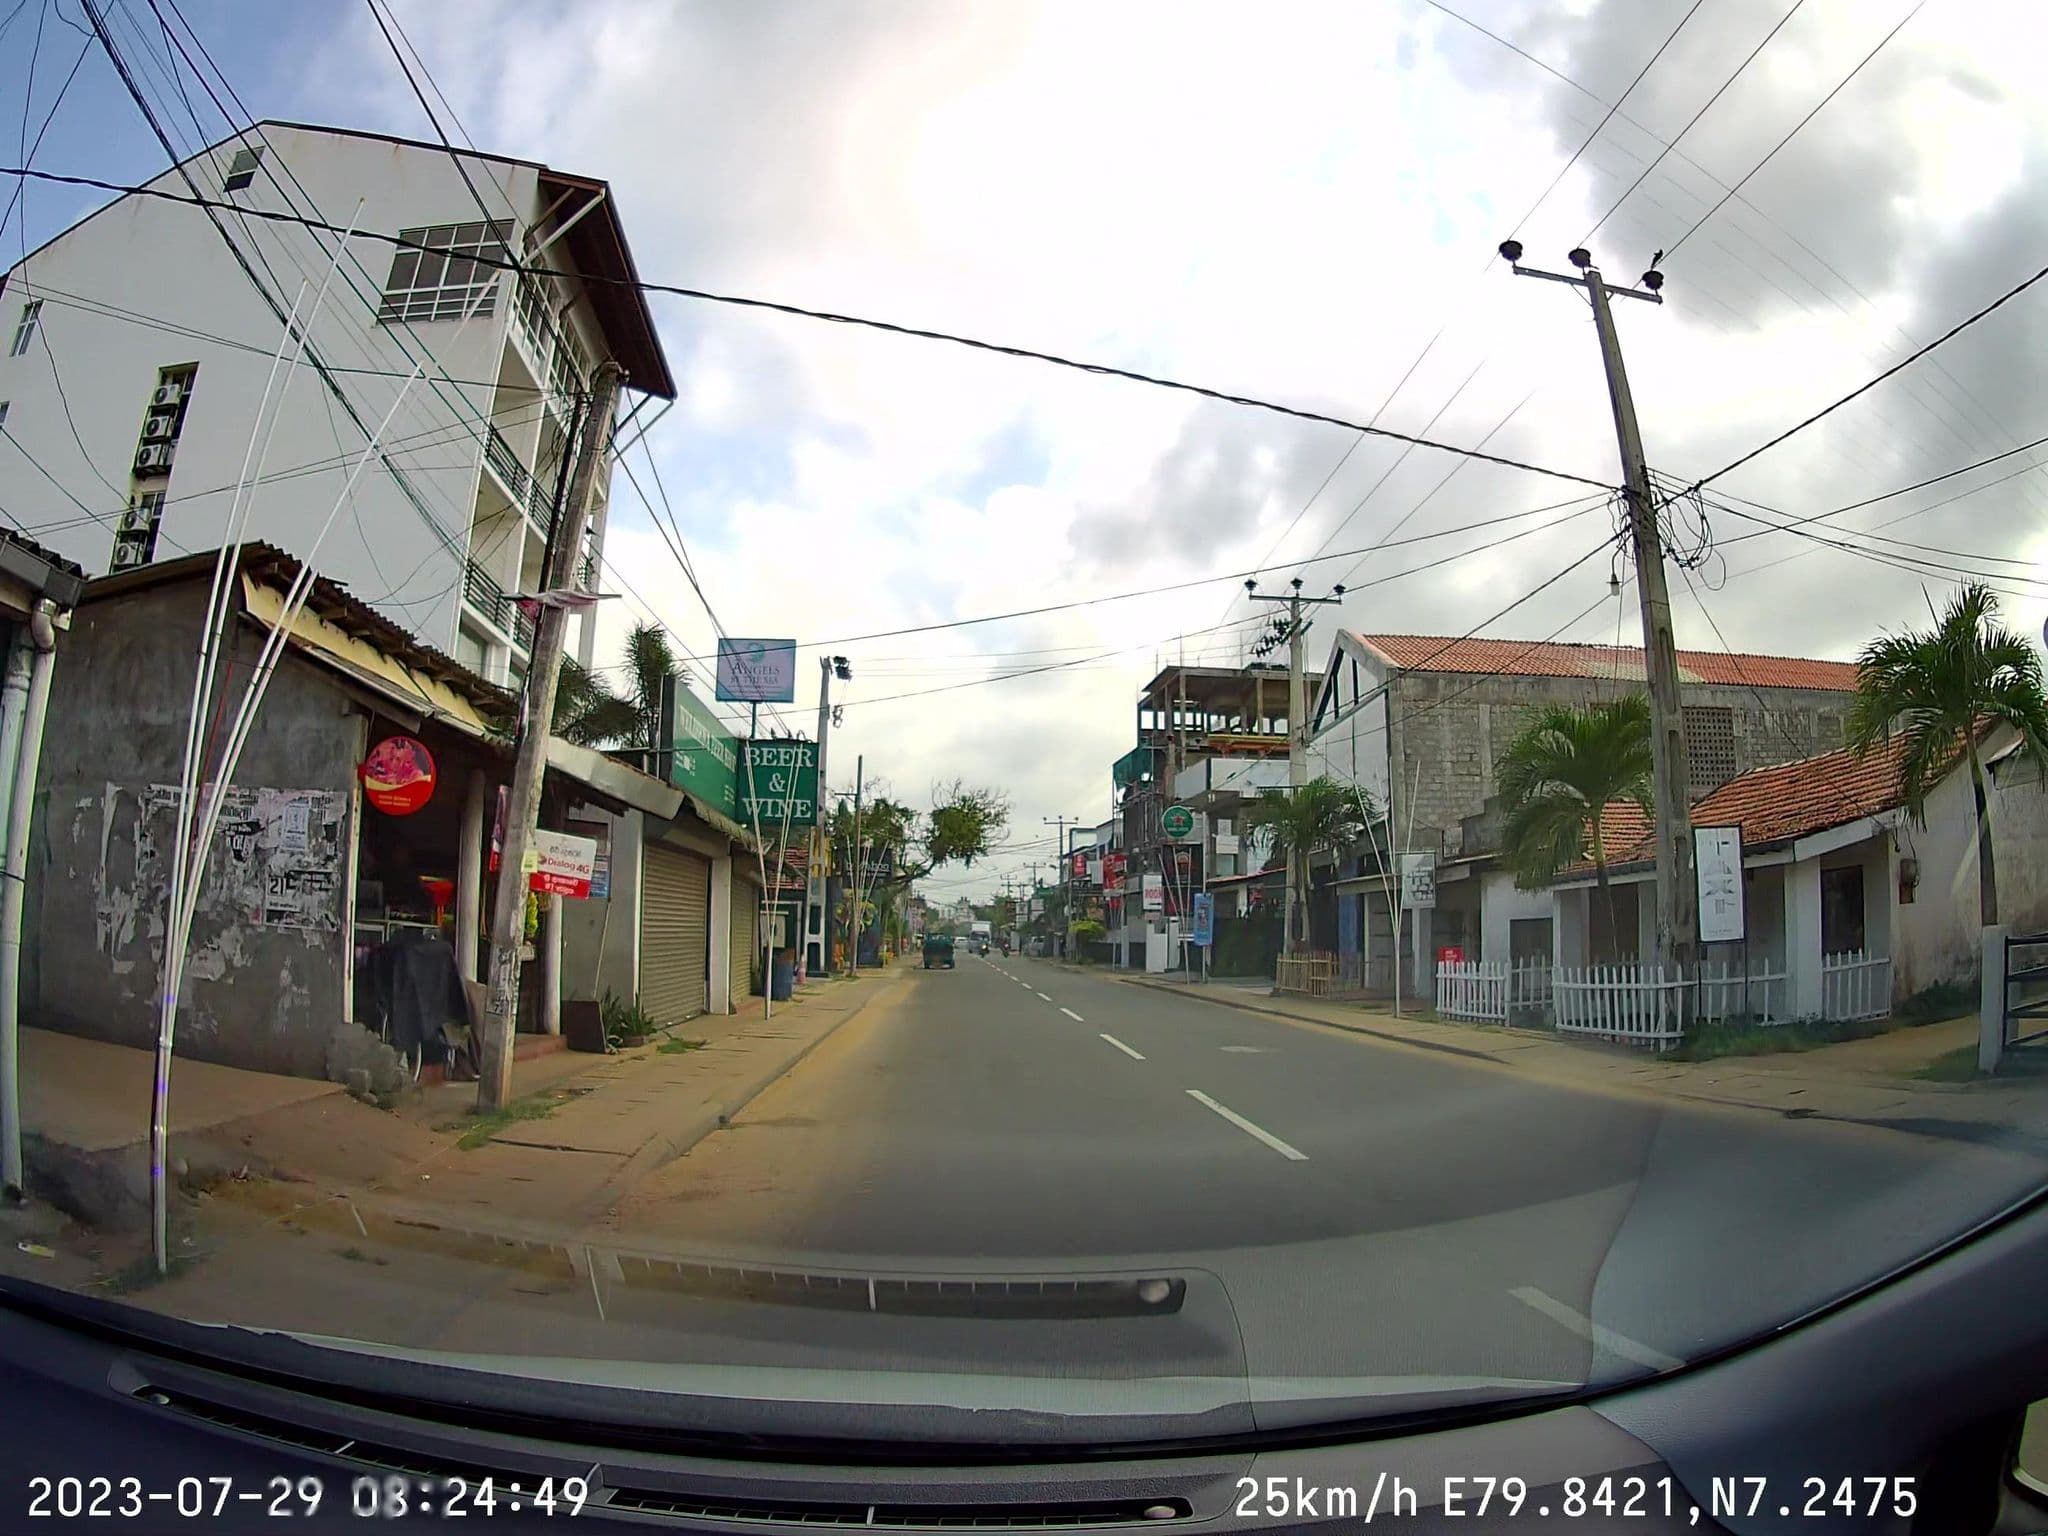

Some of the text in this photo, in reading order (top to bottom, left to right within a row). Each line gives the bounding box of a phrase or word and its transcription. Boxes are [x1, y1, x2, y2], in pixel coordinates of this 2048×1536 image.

[744, 747, 814, 768] BEER
[769, 772, 785, 792] &
[742, 797, 811, 818] WINE
[547, 857, 576, 871] Dialog
[576, 864, 590, 874] 4G
